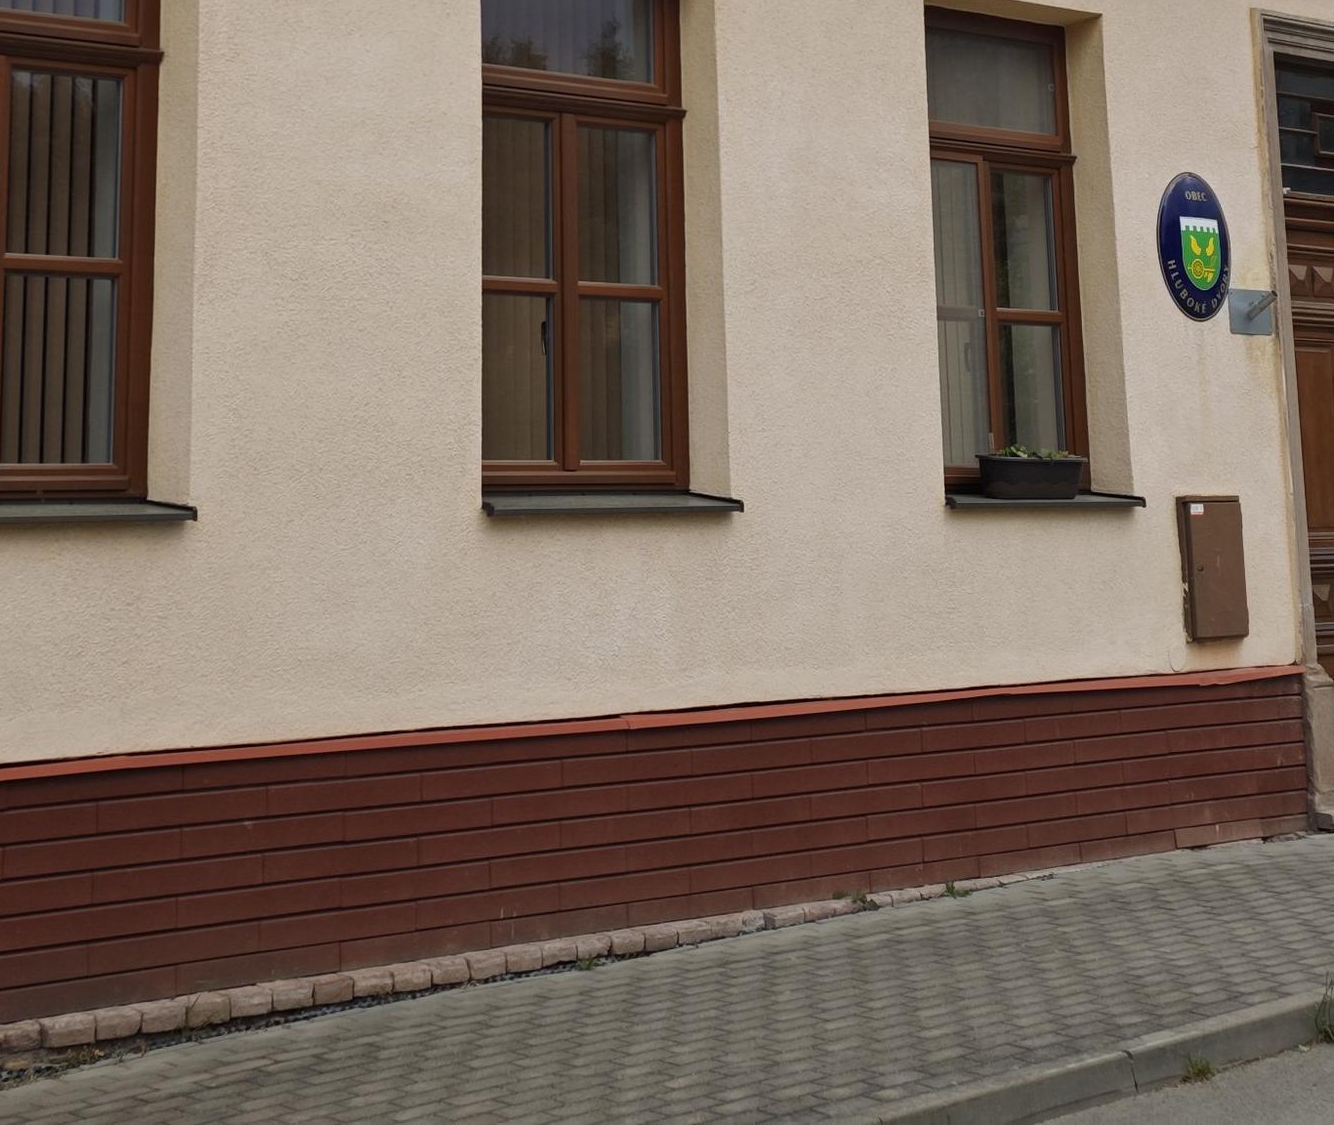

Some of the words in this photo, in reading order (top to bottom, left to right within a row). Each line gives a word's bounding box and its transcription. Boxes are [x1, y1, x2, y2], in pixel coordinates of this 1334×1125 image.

[1185, 190, 1207, 202] OBEC
[1167, 259, 1207, 314] HLUBOKÉ
[1211, 266, 1230, 309] DVORY
